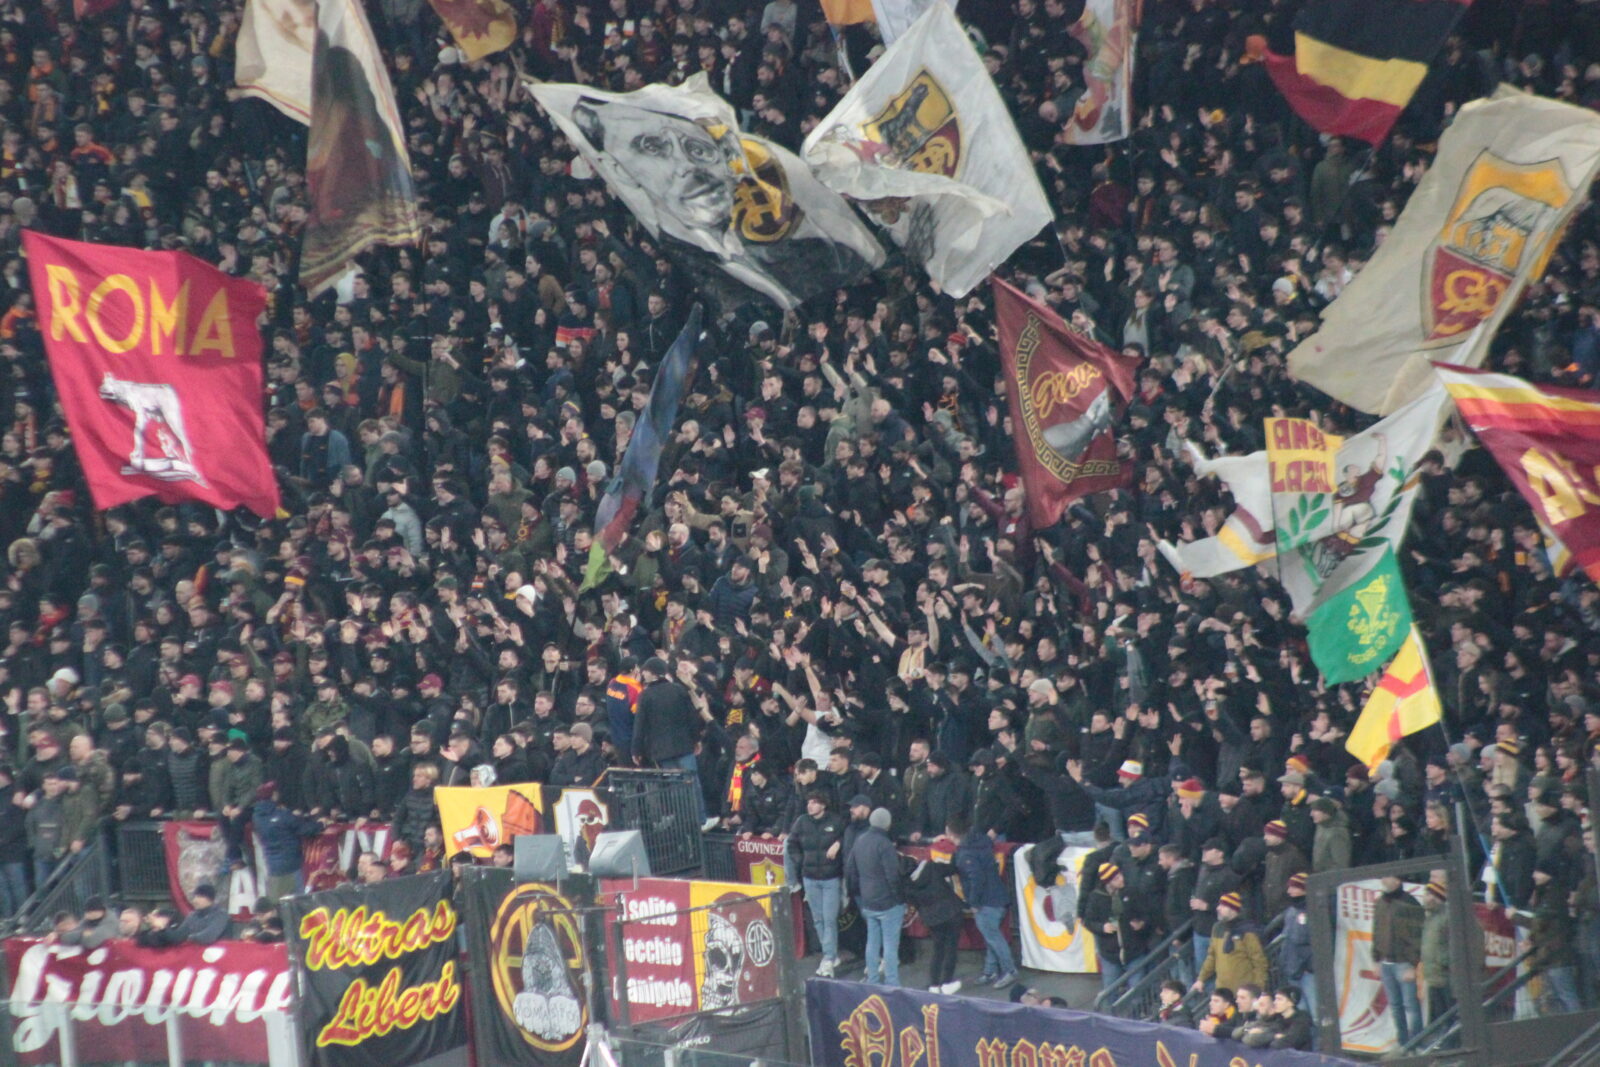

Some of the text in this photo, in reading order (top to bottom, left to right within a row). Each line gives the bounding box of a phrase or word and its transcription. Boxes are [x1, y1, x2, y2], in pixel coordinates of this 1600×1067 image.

[46, 264, 236, 358] ROMA
[300, 899, 457, 971] Ultras
[623, 937, 683, 967] ecchio
[317, 960, 461, 1047] Liberi
